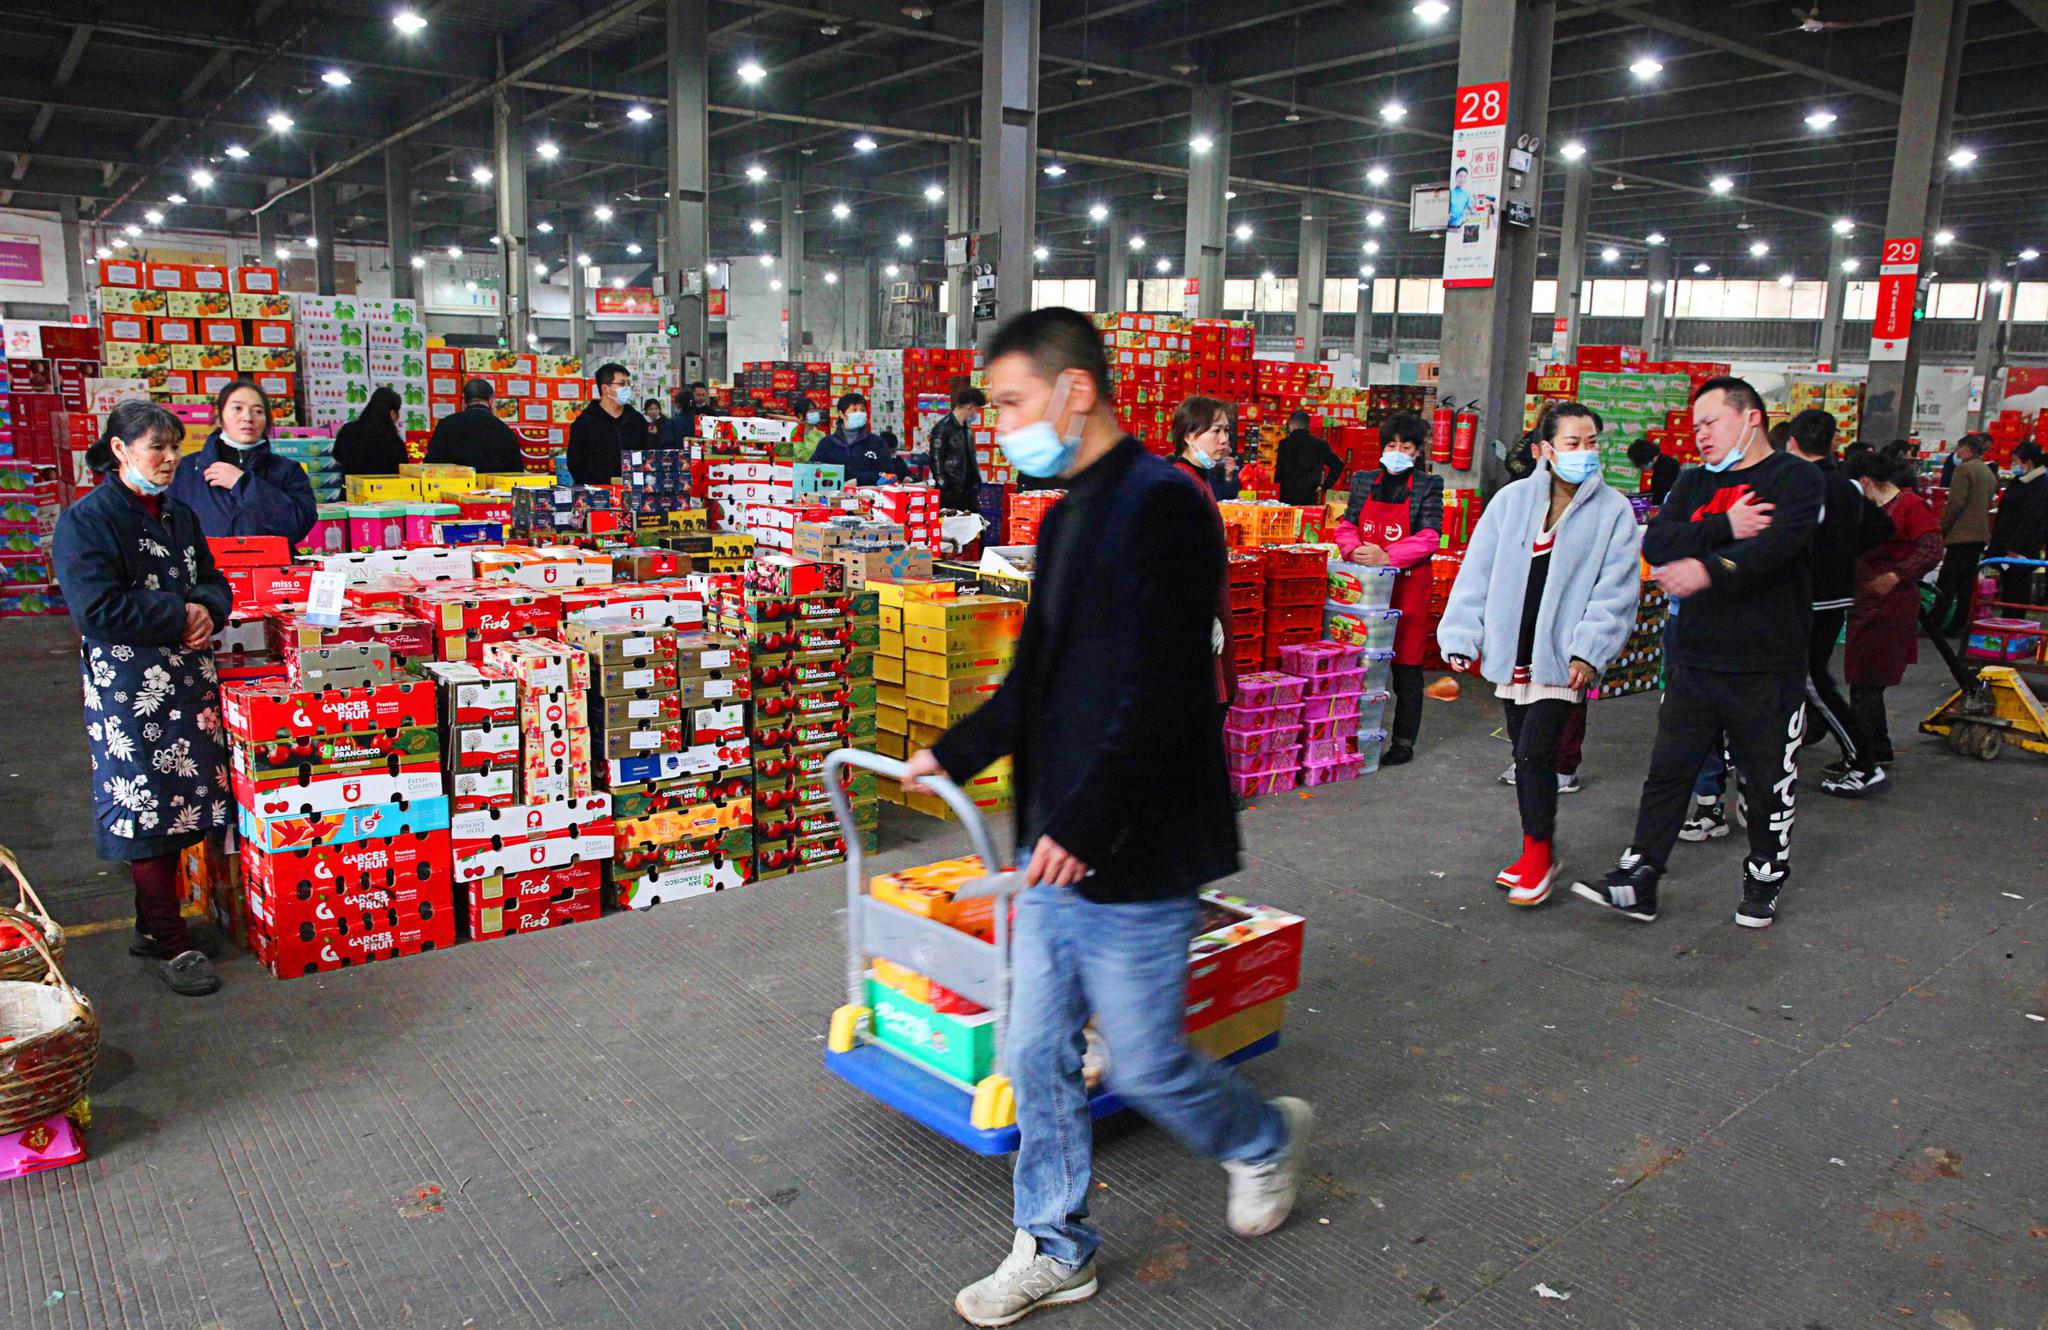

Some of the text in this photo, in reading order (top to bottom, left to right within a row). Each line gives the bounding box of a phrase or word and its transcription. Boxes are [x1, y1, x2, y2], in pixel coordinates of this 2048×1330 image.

[1461, 89, 1500, 123] 28
[1887, 242, 1915, 261] 29
[272, 580, 292, 588] miss
[322, 700, 368, 714] GARCES
[808, 701, 839, 709] FRANCISCO
[338, 709, 370, 721] FRUIT
[806, 732, 838, 740] FRANCISCO
[334, 744, 351, 752] SAN
[334, 747, 381, 758] FRANCISCO
[662, 787, 698, 798] FRANCISCO
[343, 850, 386, 865] GARCES
[674, 850, 710, 860] FRANCISCO
[809, 849, 840, 859] FRANCISCO
[357, 858, 389, 871] FRUIT
[664, 875, 702, 886] FRANCISCO
[344, 890, 388, 905] GARCES
[359, 898, 390, 911] FRUIT
[349, 931, 392, 947] GARCES
[363, 938, 394, 952] FRUIT
[29, 1126, 49, 1148] 福
